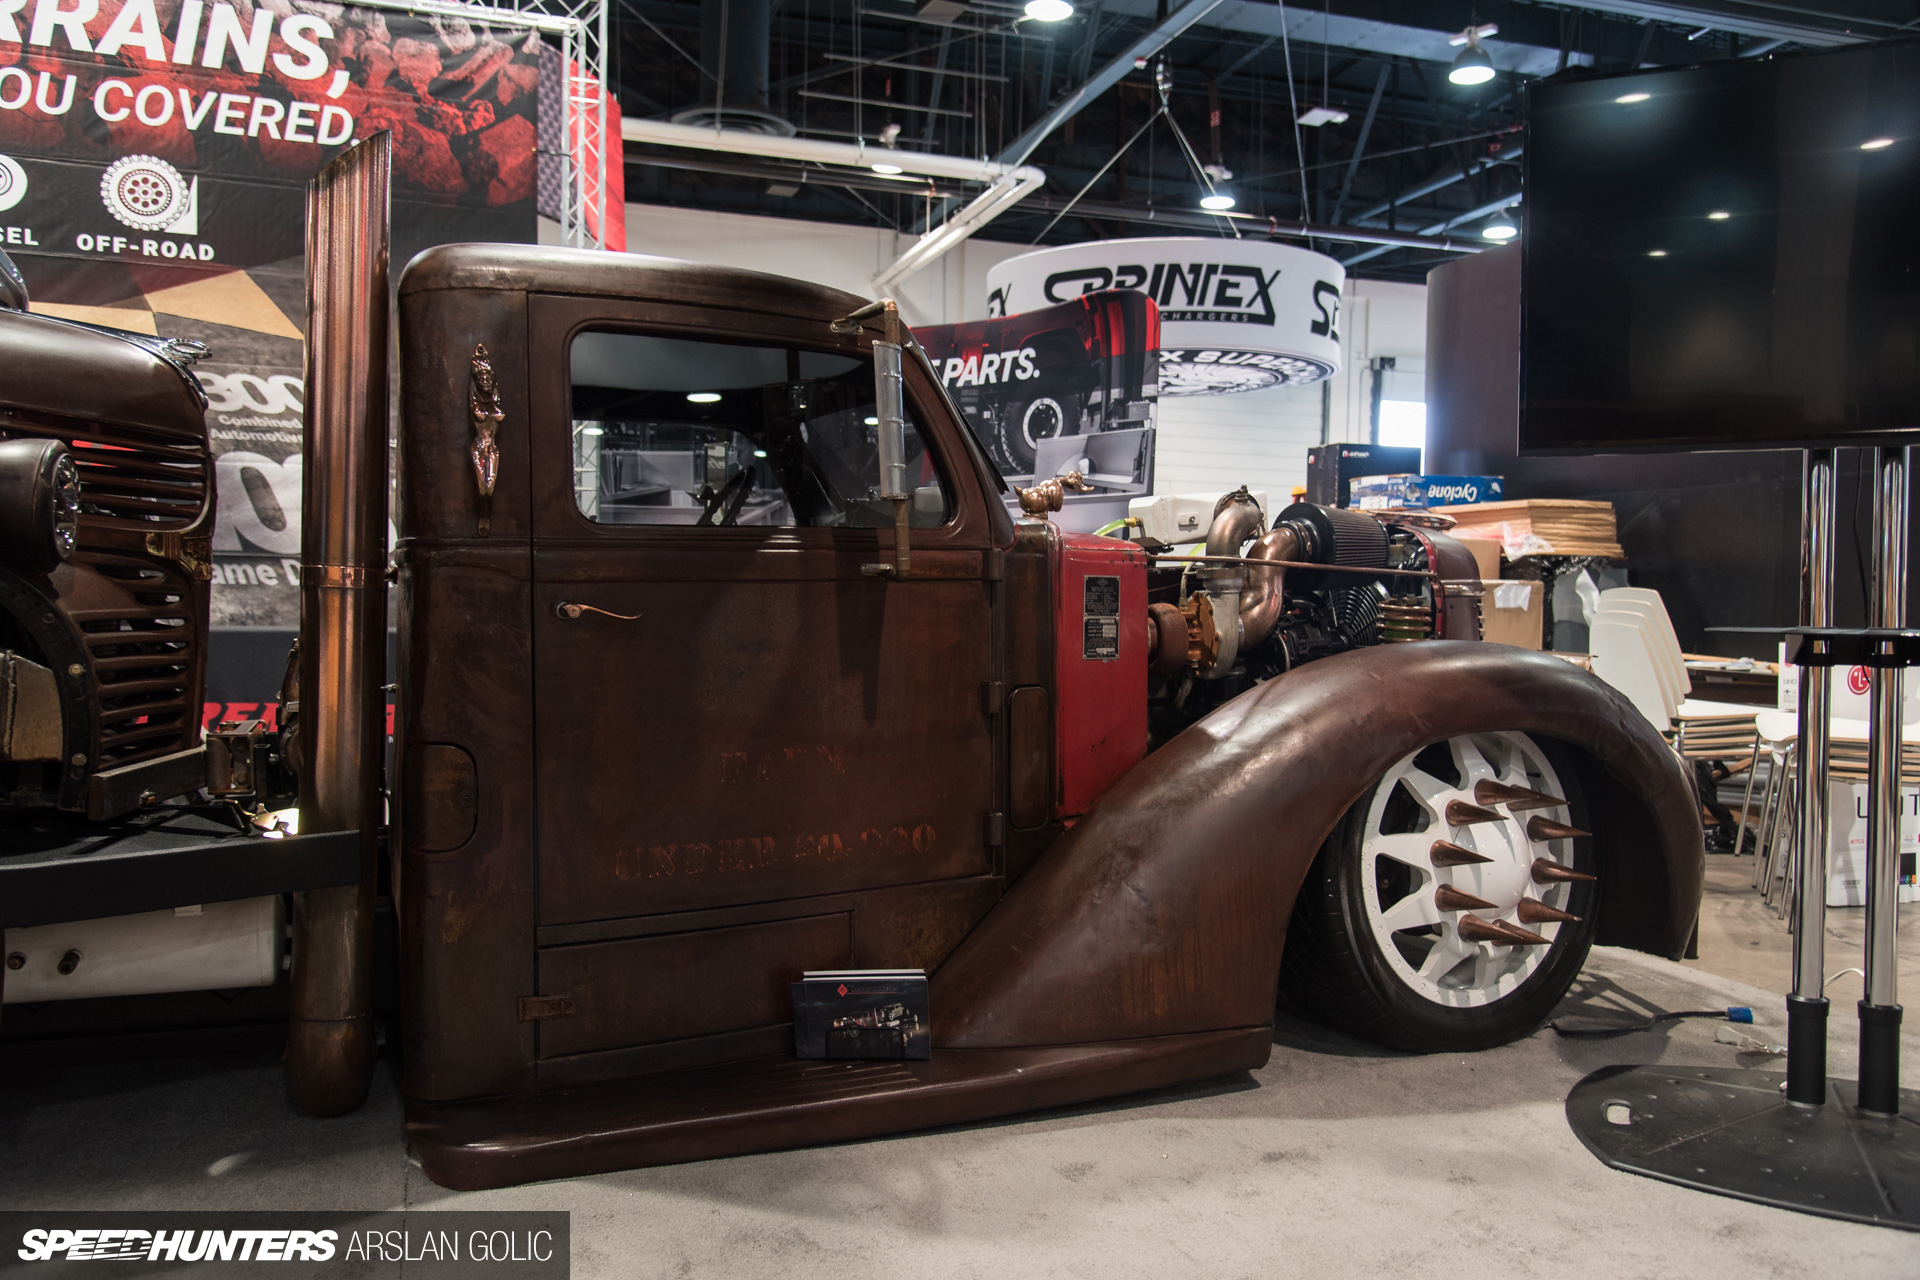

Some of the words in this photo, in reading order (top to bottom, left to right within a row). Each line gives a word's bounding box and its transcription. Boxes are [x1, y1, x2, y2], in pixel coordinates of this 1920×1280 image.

[93, 79, 361, 147] COVERED.
[76, 233, 215, 261] OFF-ROAD
[941, 347, 1040, 388] PARTS.
[217, 415, 303, 428] Combined
[1428, 484, 1478, 502] Cyclone
